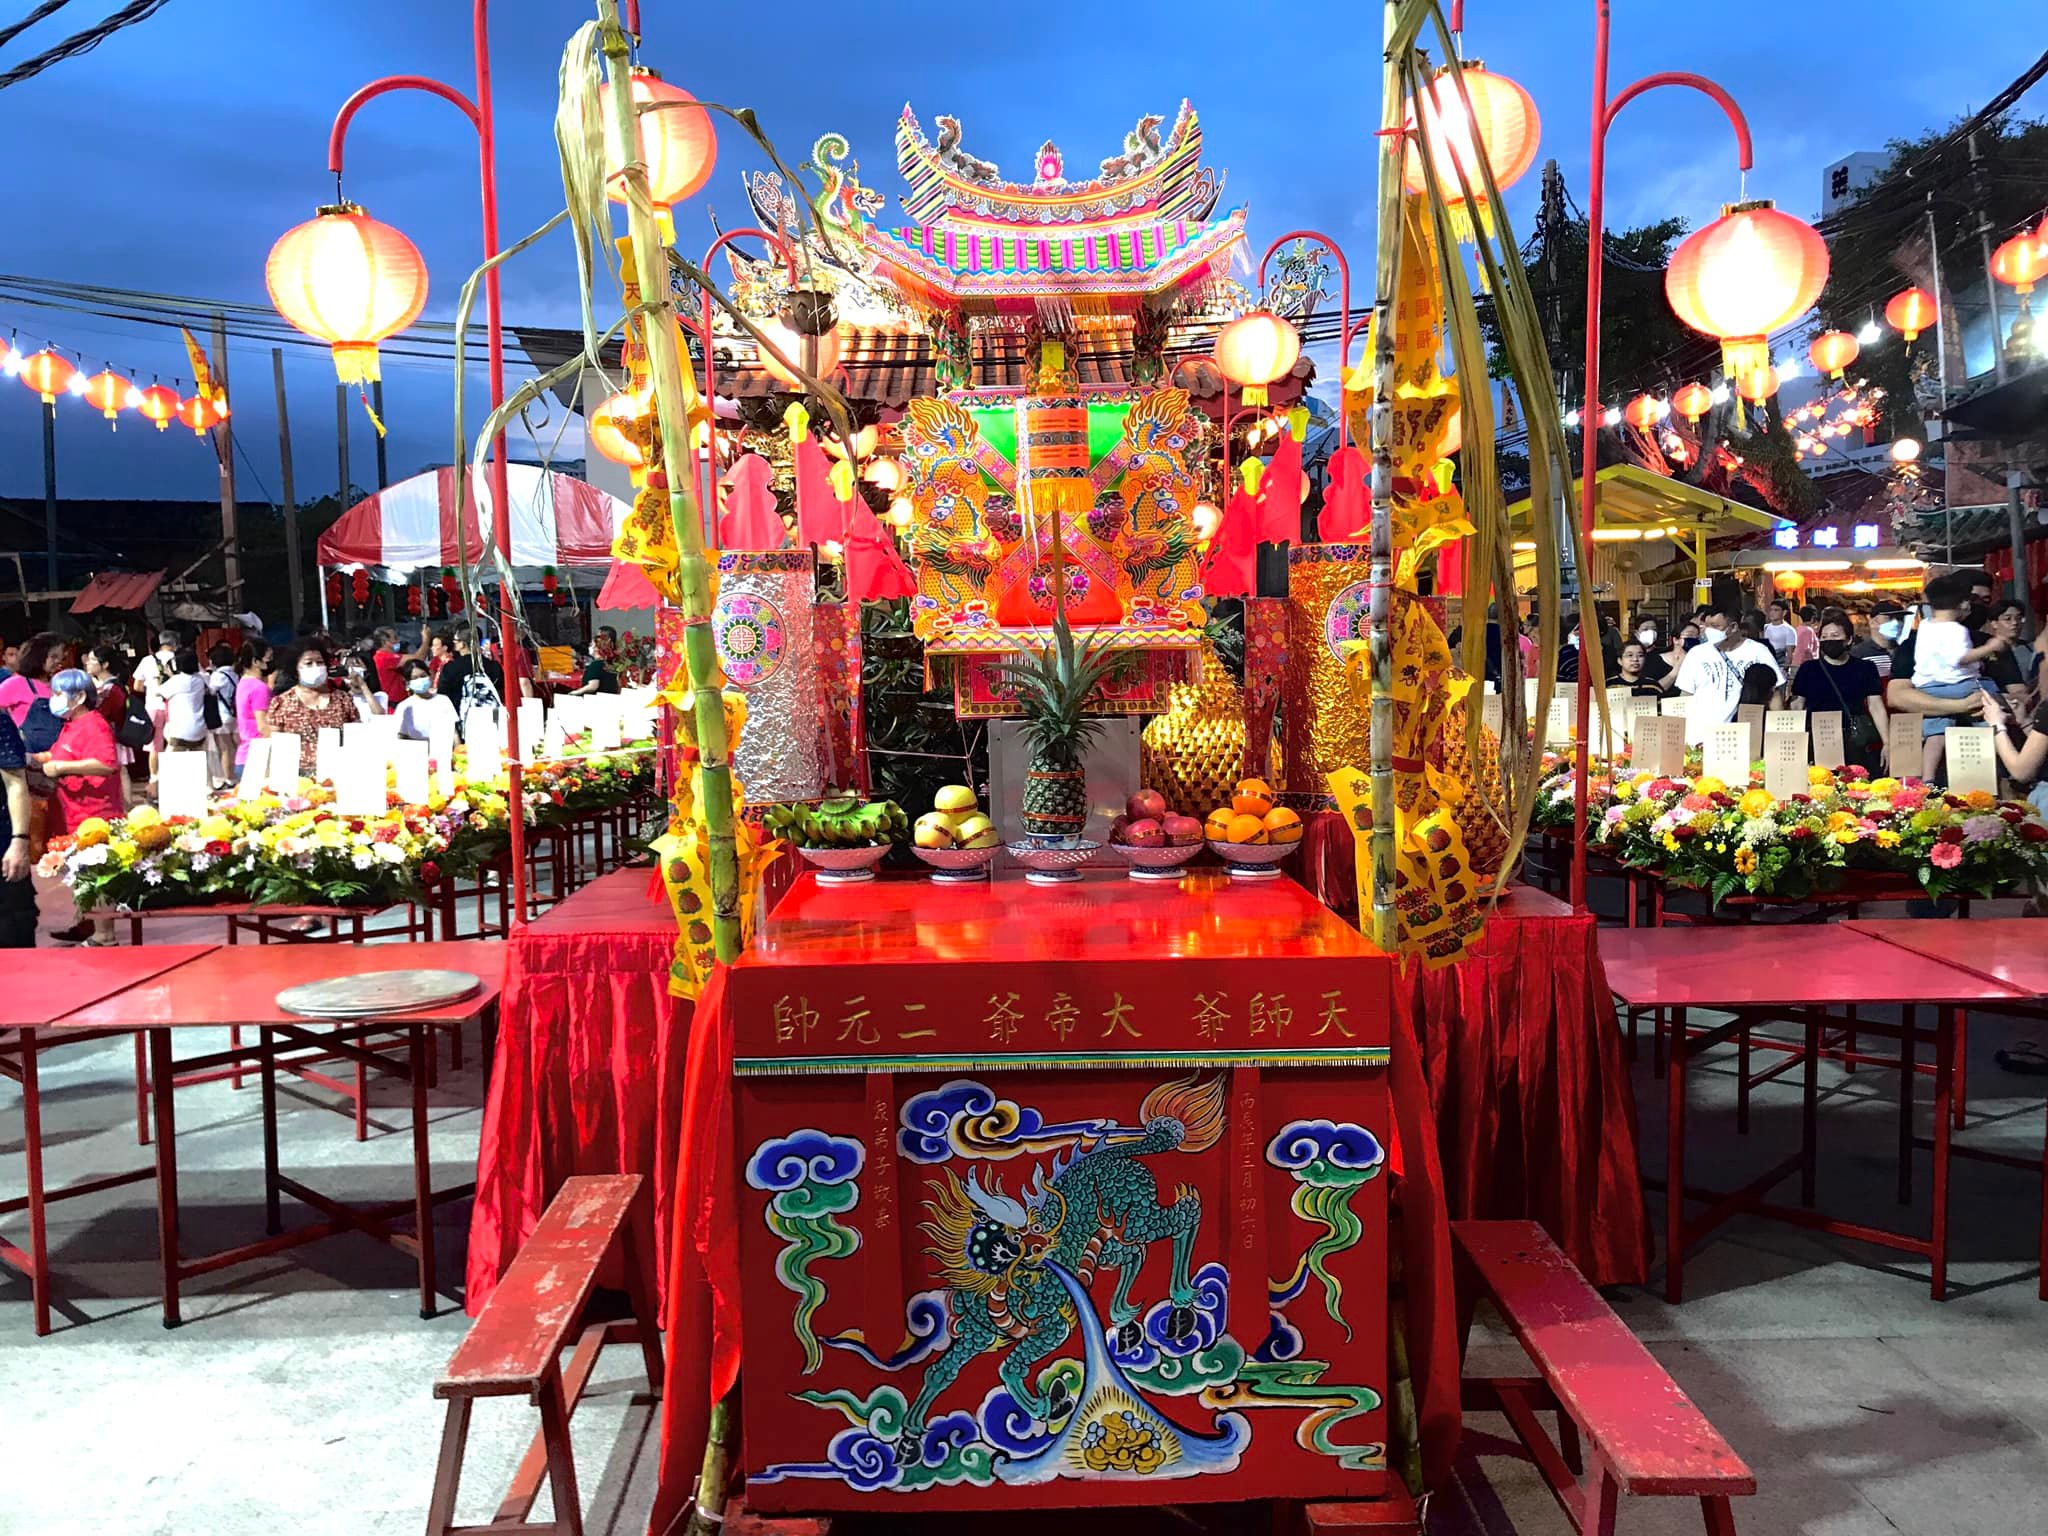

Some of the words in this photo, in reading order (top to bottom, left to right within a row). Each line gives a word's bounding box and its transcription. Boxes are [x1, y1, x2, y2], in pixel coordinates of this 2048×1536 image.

[773, 995, 938, 1045] 二元帥
[982, 991, 1144, 1045] 大帝爺
[1191, 990, 1357, 1043] 天師爺
